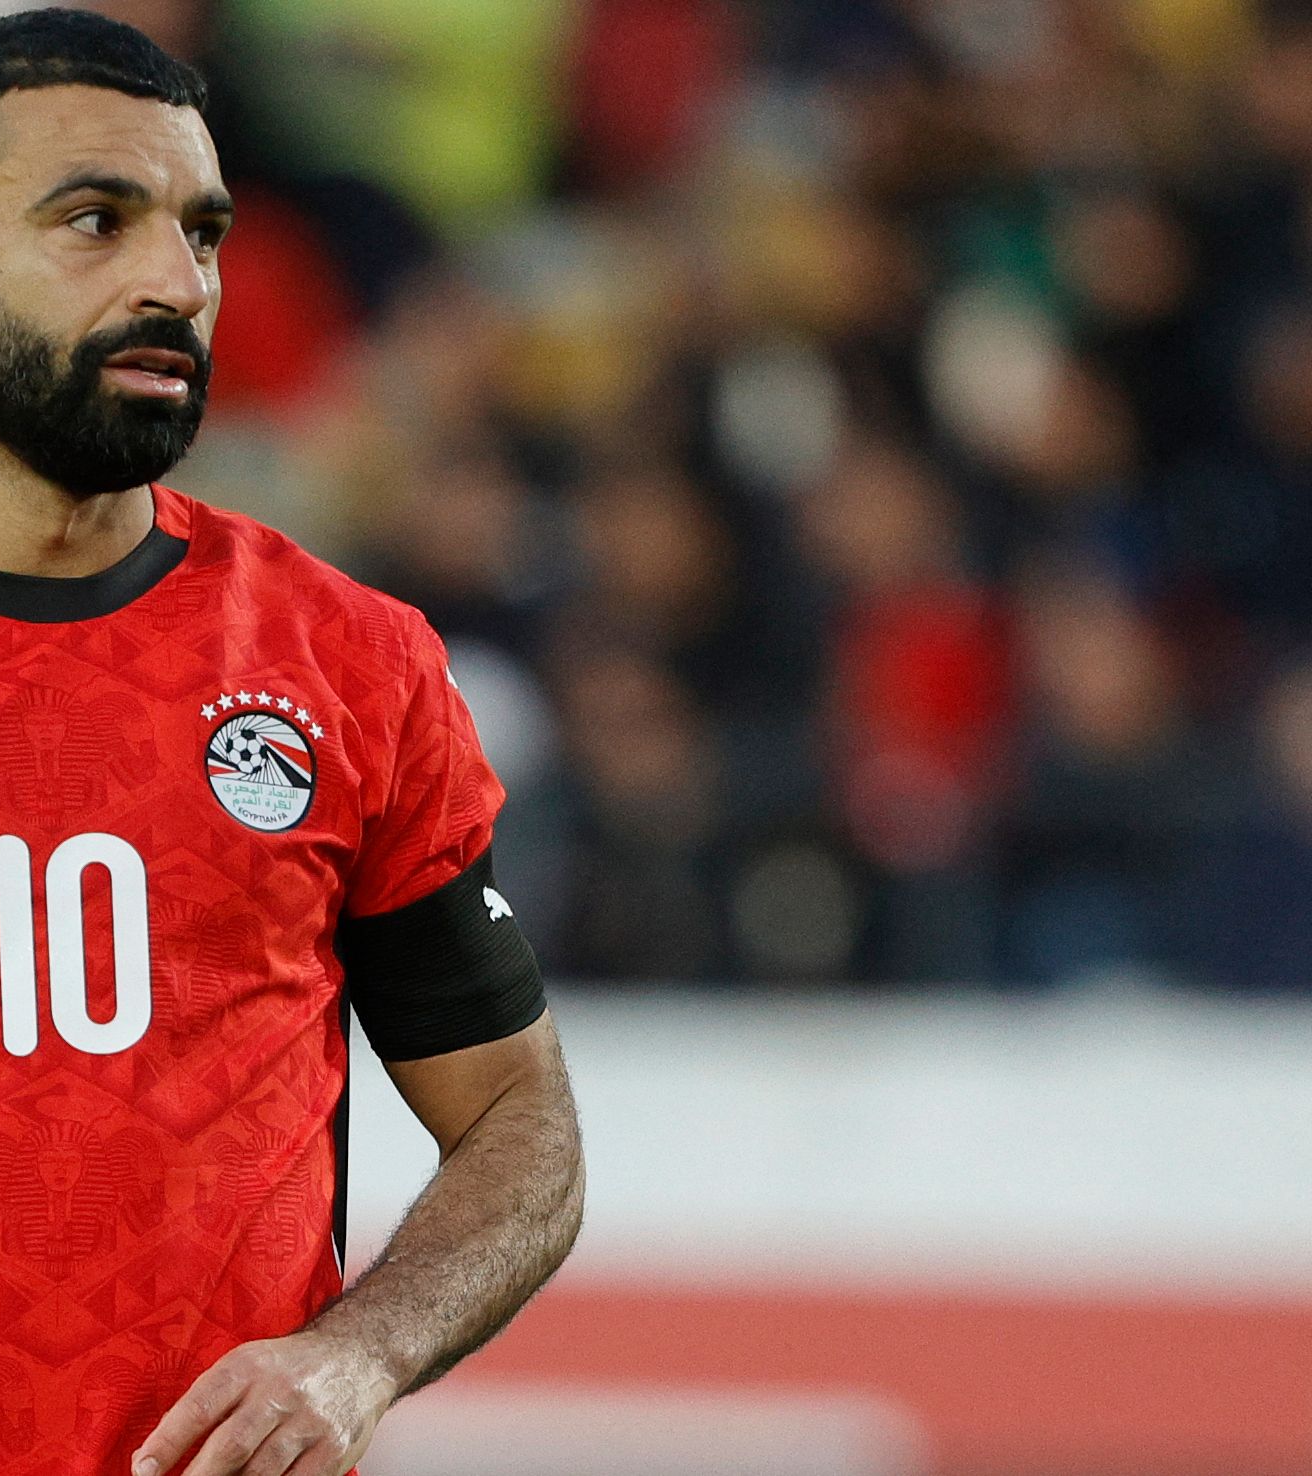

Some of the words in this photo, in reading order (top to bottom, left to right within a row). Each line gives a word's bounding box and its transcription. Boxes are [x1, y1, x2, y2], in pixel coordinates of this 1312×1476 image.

[232, 796, 261, 807] القدم
[238, 807, 277, 823] EGYPTIAN
[278, 812, 288, 820] FA
